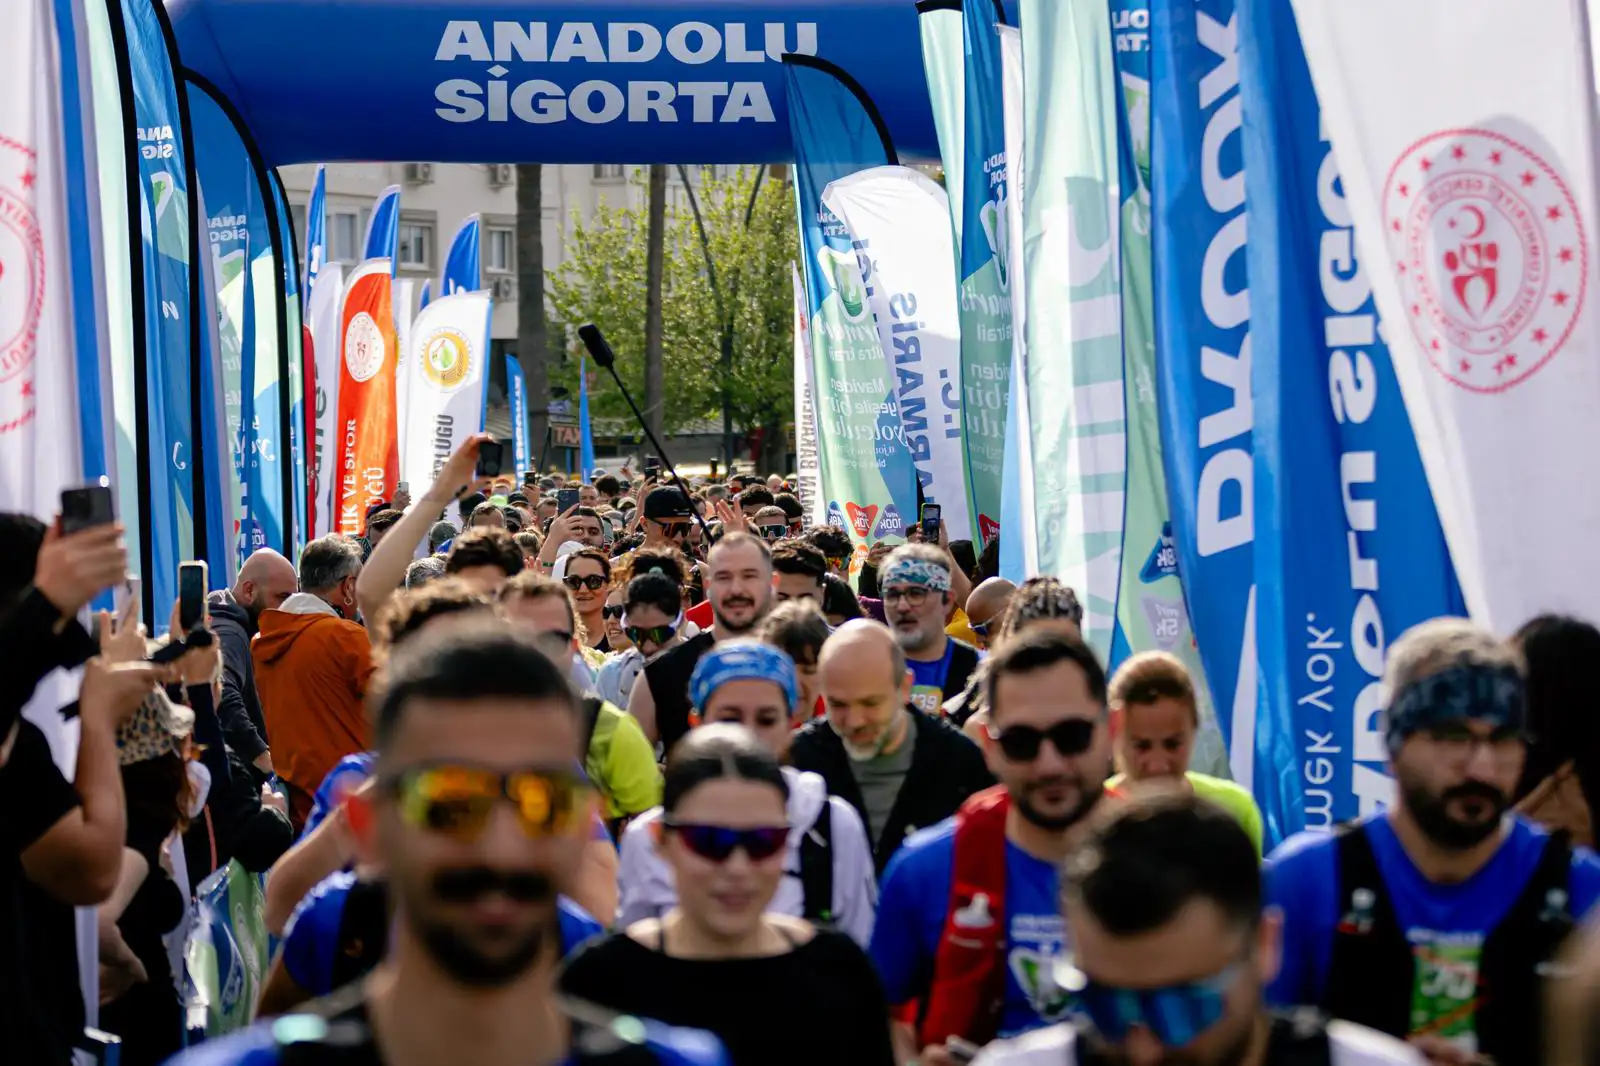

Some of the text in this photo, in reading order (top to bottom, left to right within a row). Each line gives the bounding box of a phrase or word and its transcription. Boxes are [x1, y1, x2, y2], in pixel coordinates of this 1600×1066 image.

[434, 20, 818, 64] ANADOLU
[434, 64, 777, 124] SİGORTA
[344, 419, 358, 471] SPOR
[341, 473, 358, 500] VE
